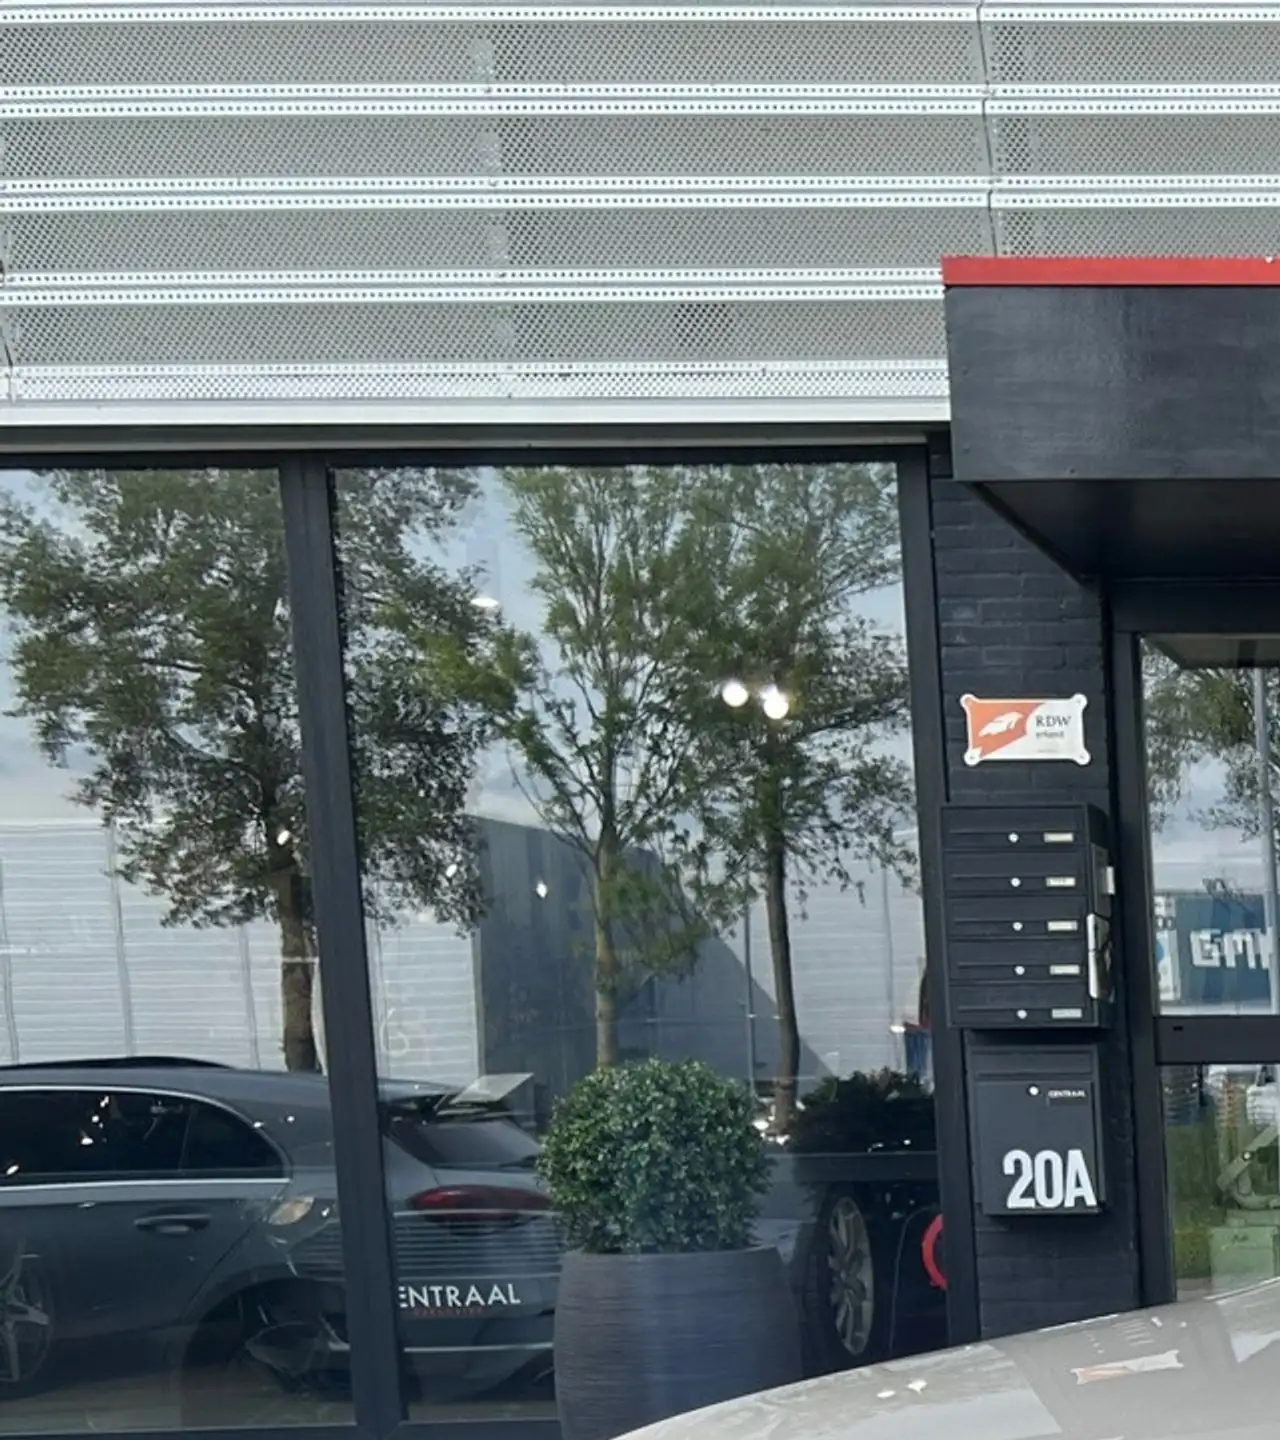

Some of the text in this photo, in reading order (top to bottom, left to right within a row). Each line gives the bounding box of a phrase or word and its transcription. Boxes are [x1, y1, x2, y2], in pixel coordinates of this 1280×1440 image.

[1035, 715, 1072, 727] RDW
[1002, 1148, 1098, 1209] 20A
[398, 1283, 521, 1308] ENTRAAL
